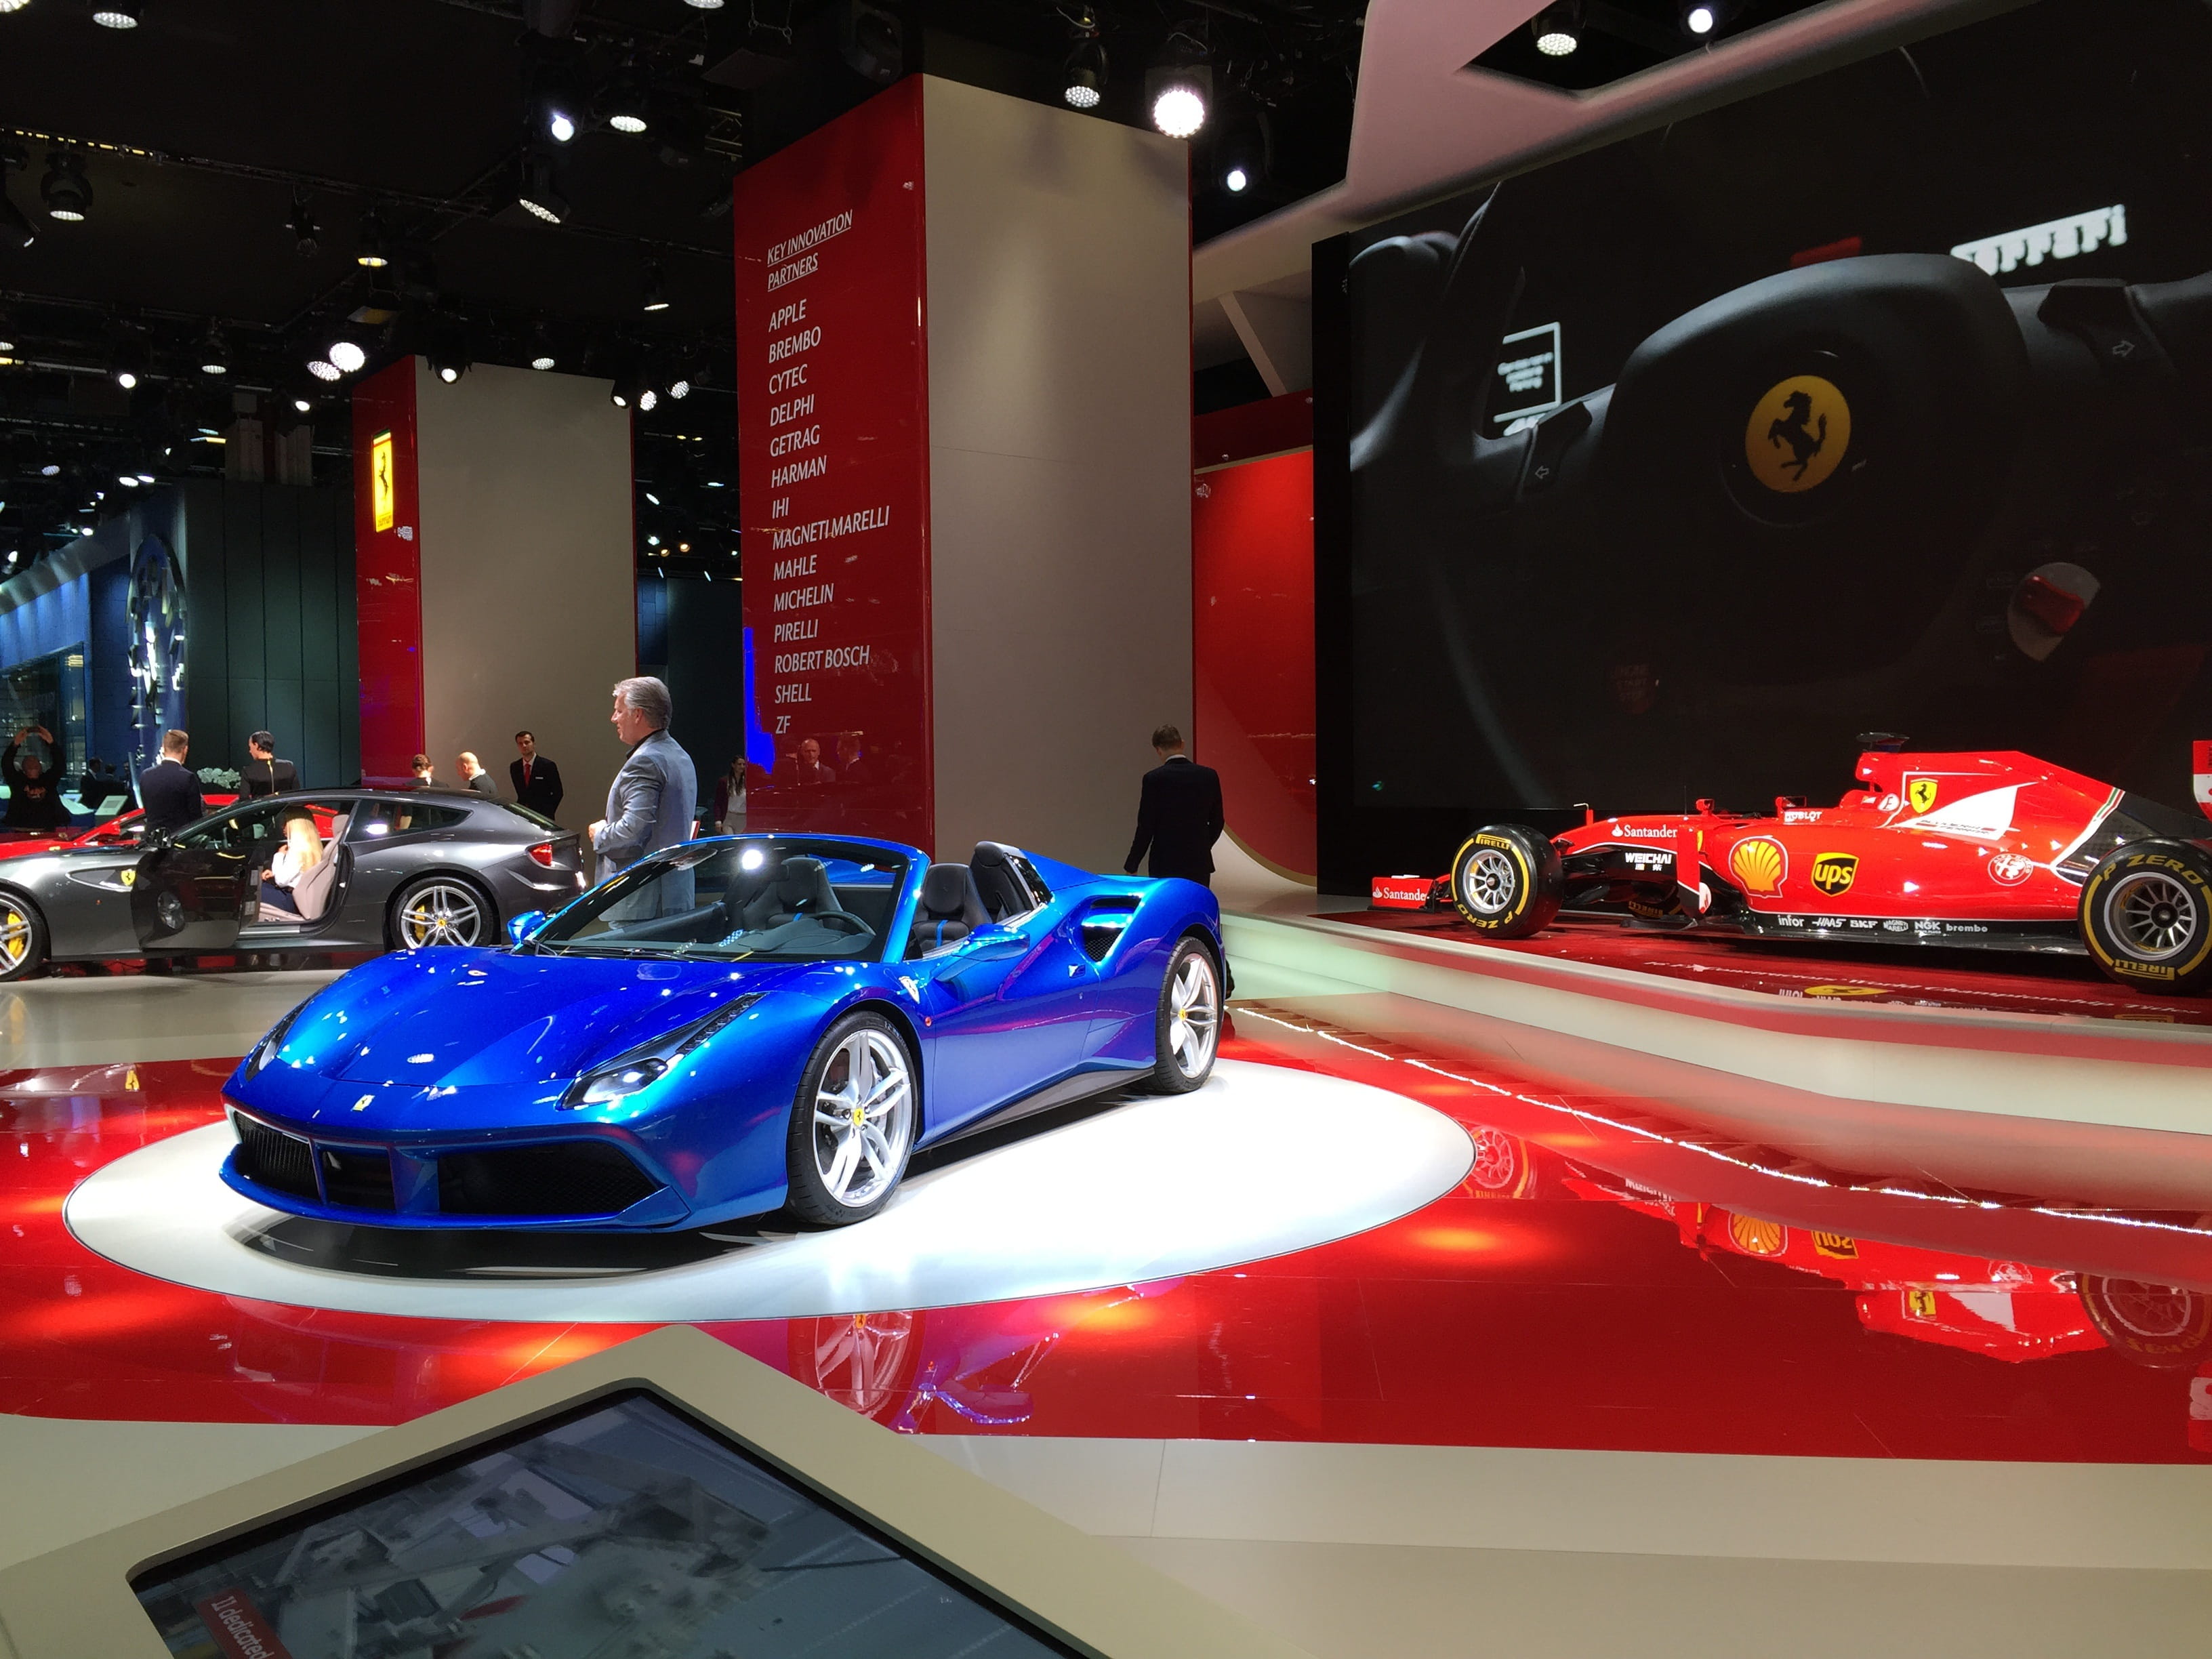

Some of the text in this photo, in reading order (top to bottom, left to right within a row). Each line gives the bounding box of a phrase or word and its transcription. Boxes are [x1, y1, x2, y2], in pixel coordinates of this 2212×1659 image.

[767, 209, 853, 265] KEY INNOVATION
[767, 253, 819, 289] PARTNERS
[769, 299, 806, 333] APPLE
[769, 326, 821, 364] BREMBO
[769, 364, 808, 394] CYTEC
[770, 394, 815, 427] DELPHI
[770, 424, 820, 457] GETRAG
[771, 455, 827, 489] HARMAN
[772, 497, 790, 519] IHI
[773, 505, 890, 550] MAGNETI MARELLI
[773, 554, 817, 581] MAHLE
[773, 583, 834, 613] MICHELIN
[774, 619, 819, 643] PIRELLI
[775, 644, 870, 674] ROBERT BOSCH
[775, 682, 812, 704] SHELL
[775, 715, 792, 735] ZF
[1475, 834, 1512, 850] PIRELLI
[1624, 823, 1678, 838] Santander
[1624, 852, 1673, 865] WEICHAI
[2103, 853, 2205, 885] P ZERO
[1815, 863, 1853, 890] ups
[1457, 903, 1513, 929] P ZERO
[1777, 914, 1805, 927] infor
[1811, 917, 1847, 928] HAAS
[1849, 920, 1879, 928] SKF
[1914, 921, 1941, 930] NGK
[1946, 923, 1988, 933] brembo
[2114, 959, 2175, 981] PIRELLI
[211, 1595, 275, 1659] 11 dedicated
